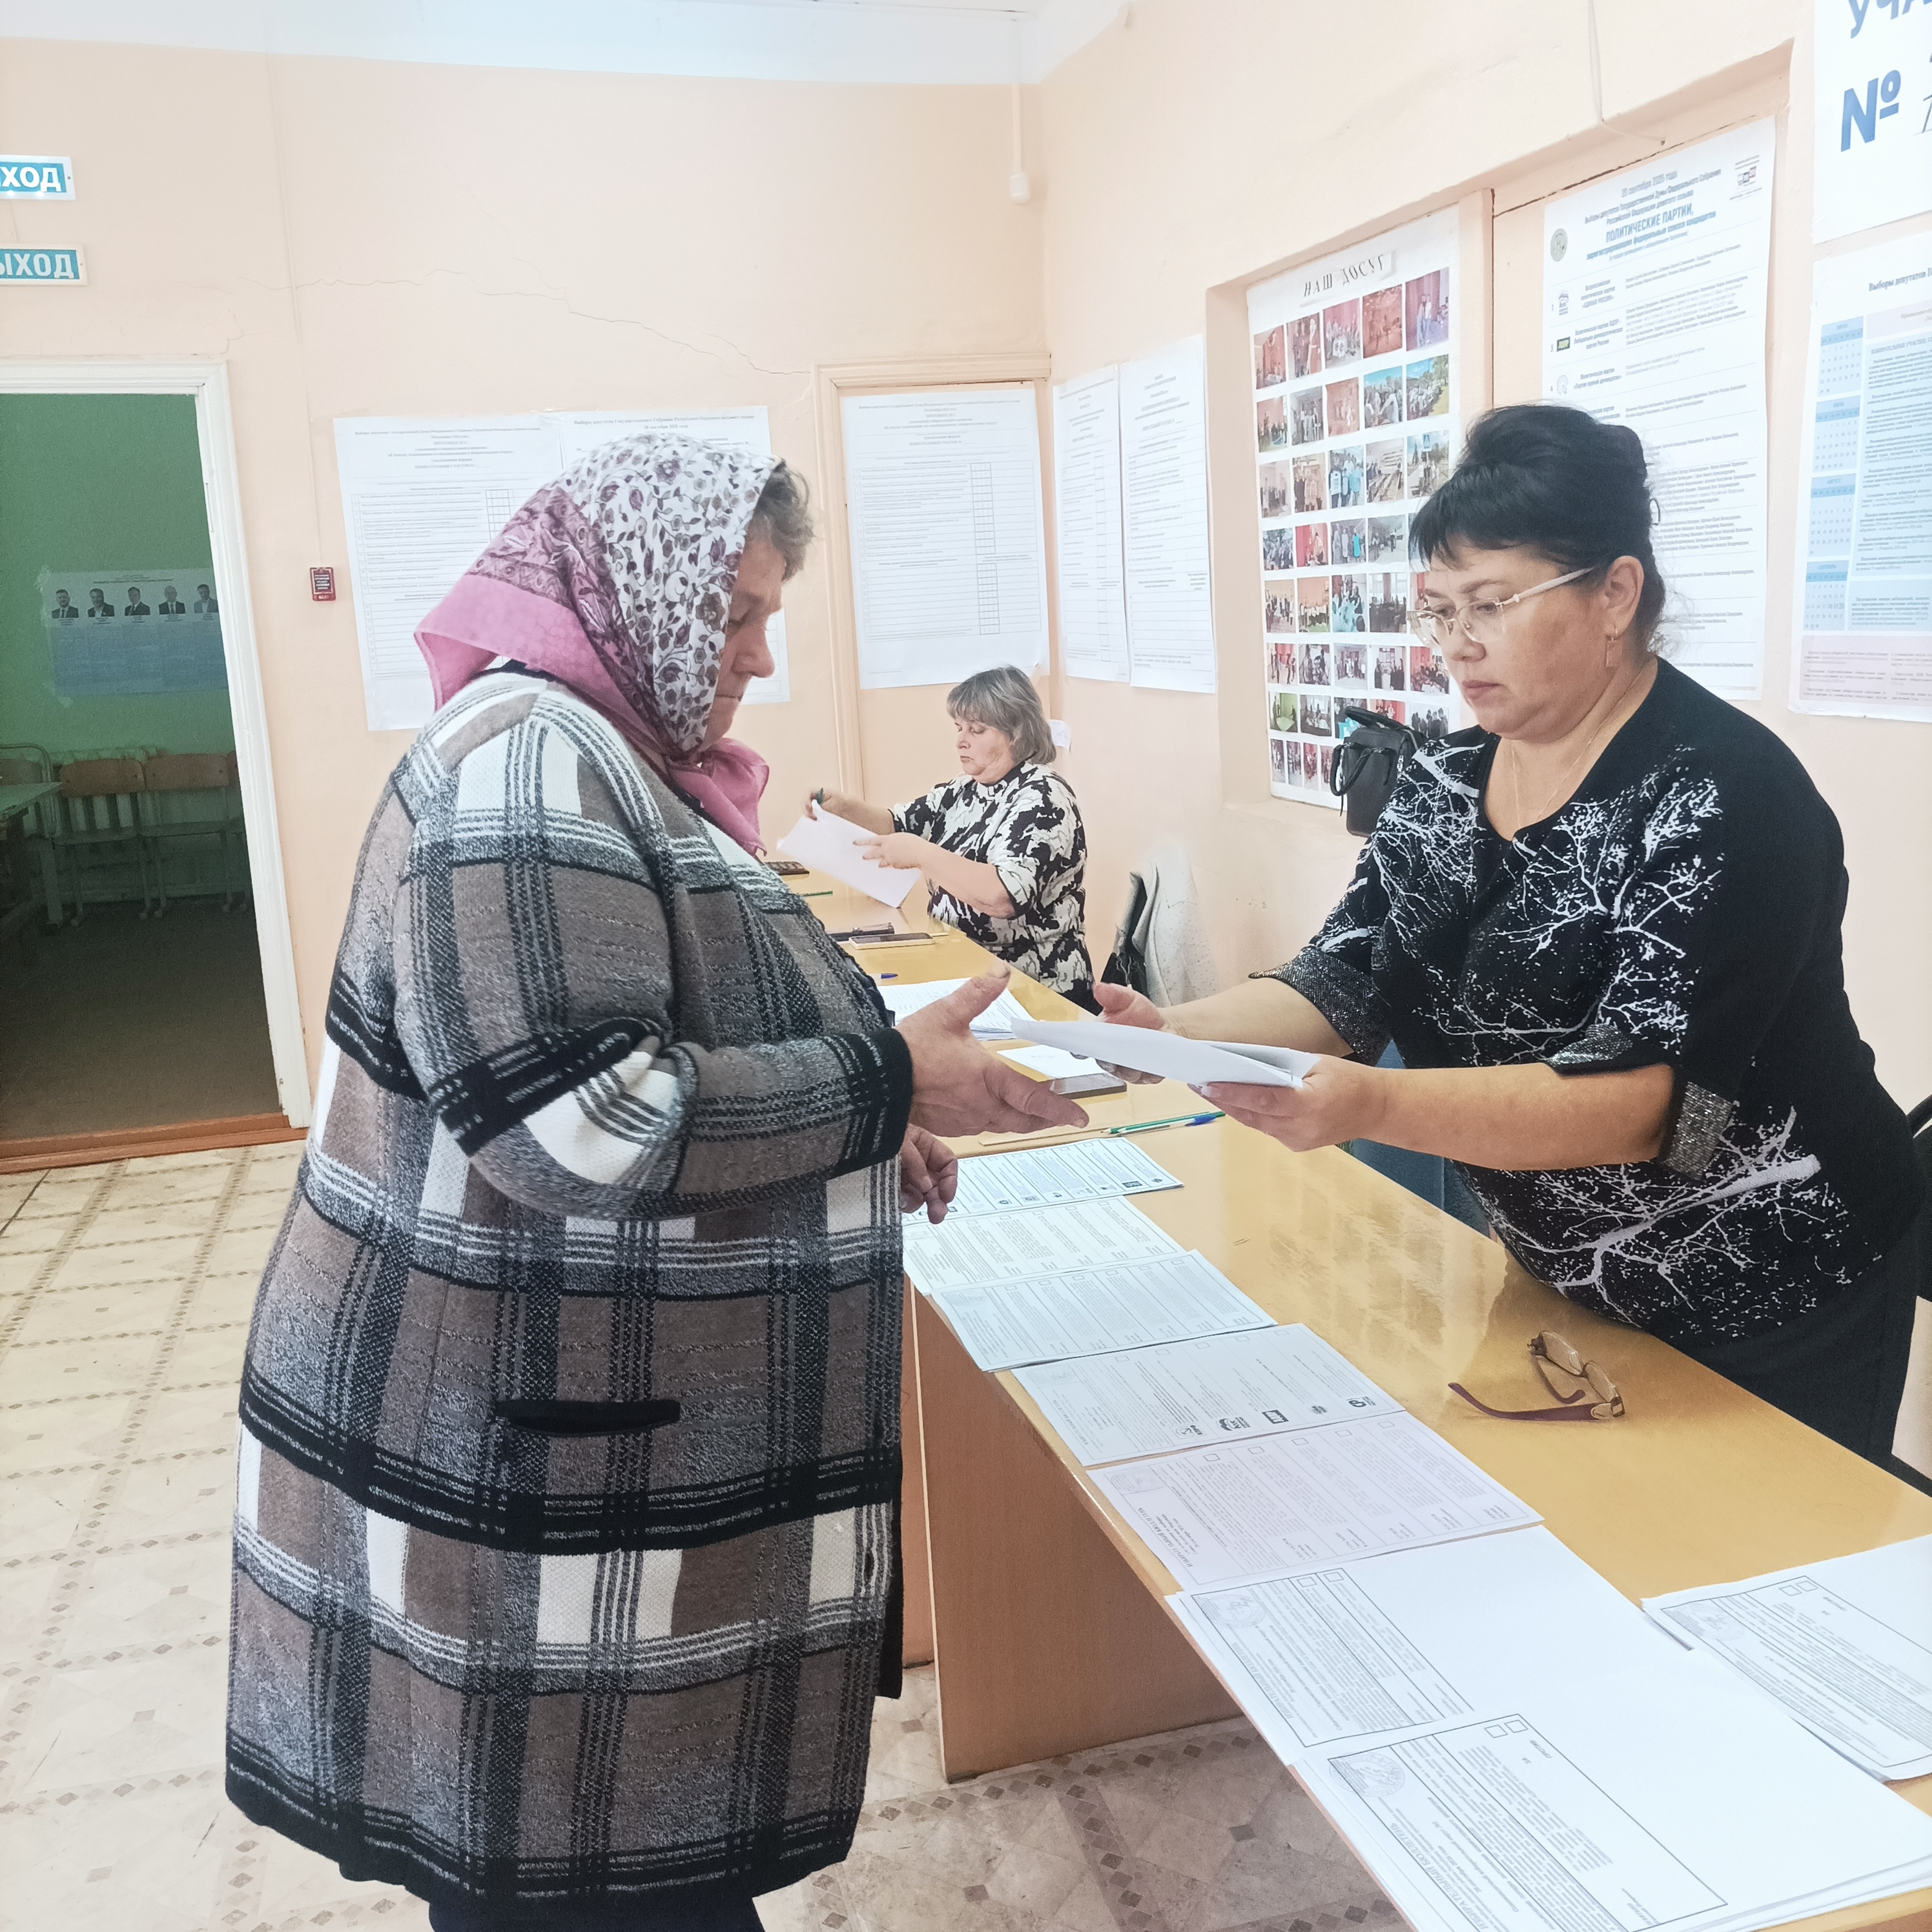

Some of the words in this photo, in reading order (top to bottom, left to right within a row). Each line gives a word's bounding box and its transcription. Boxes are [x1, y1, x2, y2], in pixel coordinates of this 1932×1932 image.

[1841, 70, 1902, 152] №
[0, 166, 62, 192] ХОД
[1606, 214, 1660, 243] ПОЛИТИЧЕСКИЕ
[1304, 273, 1333, 297] НАШ
[1342, 254, 1384, 286] ДОСУГ
[1869, 280, 1894, 292] Выборы
[1231, 1642, 1259, 1673] БЮЛЛЕТЕНЬ
[1255, 1672, 1294, 1719] ИЗБИРАТЕЛЬНЫЙ
[1388, 1822, 1432, 1866] БЮЛЛЕТЕНЬ
[1426, 1865, 1489, 1930] ИЗБИРАТЕЛЬНЫЙ
